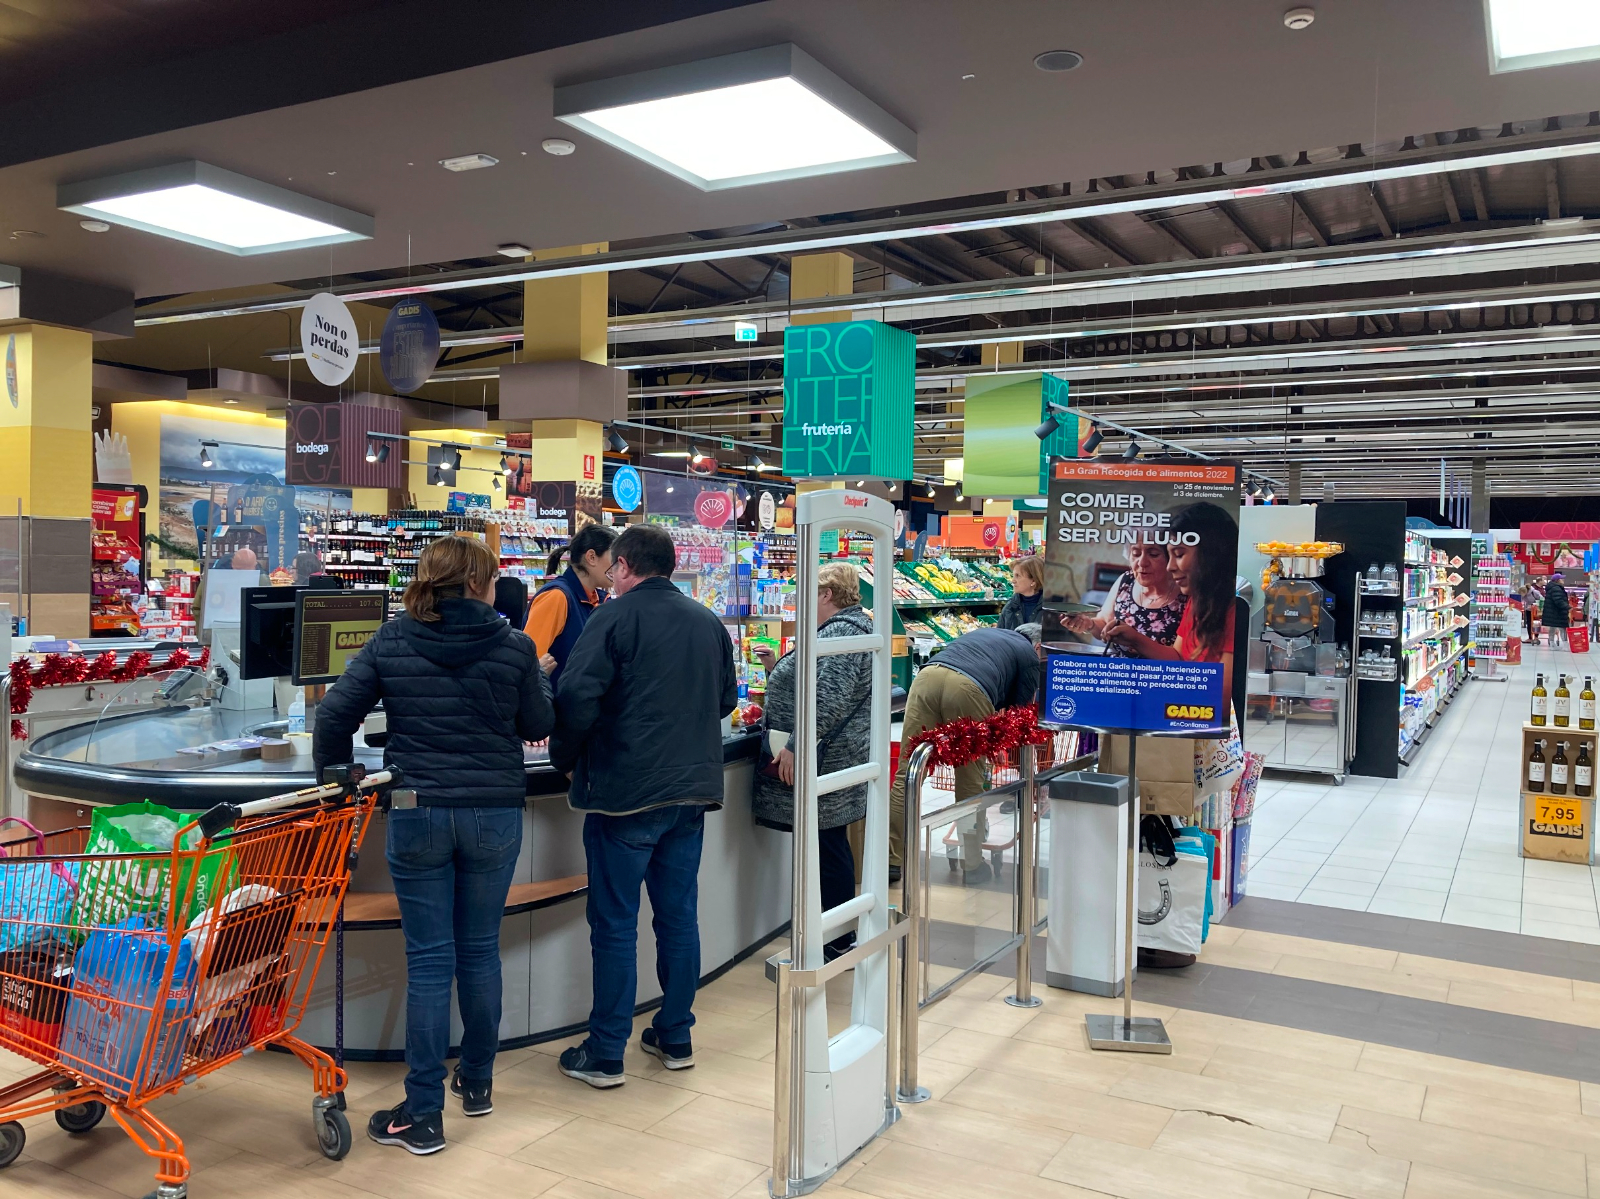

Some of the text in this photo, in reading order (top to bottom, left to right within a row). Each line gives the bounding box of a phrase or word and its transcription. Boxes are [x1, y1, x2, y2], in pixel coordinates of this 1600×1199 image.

[398, 305, 420, 316] GADIS
[315, 313, 348, 341] Non o
[309, 331, 350, 359] perdas
[782, 323, 873, 377] FRO
[802, 421, 852, 436] frutería
[296, 441, 329, 455] bodega
[1064, 467, 1228, 479] La Gran Recogida de alimentos 2022
[1060, 492, 1145, 509] COMER
[539, 508, 566, 517] bodega
[1059, 510, 1172, 527] NO PUEDE
[1058, 528, 1201, 546] SER UN LUJO
[1053, 659, 1087, 668] Colabora
[1108, 662, 1131, 670] Gadis
[1132, 663, 1164, 673] habitual,
[1165, 665, 1201, 674] haciendo
[1052, 668, 1087, 677] donación
[1088, 669, 1129, 678] económica
[1130, 671, 1138, 679] al
[1139, 673, 1161, 682] pasar
[1162, 674, 1175, 682] por
[1176, 673, 1184, 681] la
[1185, 674, 1201, 683] caja
[1052, 675, 1098, 685] depositando
[1099, 678, 1136, 687] alimentos
[1149, 681, 1196, 690] perecederos
[1052, 683, 1142, 695] los cajones señalizados.
[1166, 705, 1214, 719] GADIS
[1169, 721, 1209, 729] #EnConfianza
[1541, 806, 1575, 821] 7,95
[1532, 822, 1583, 837] GADIS
